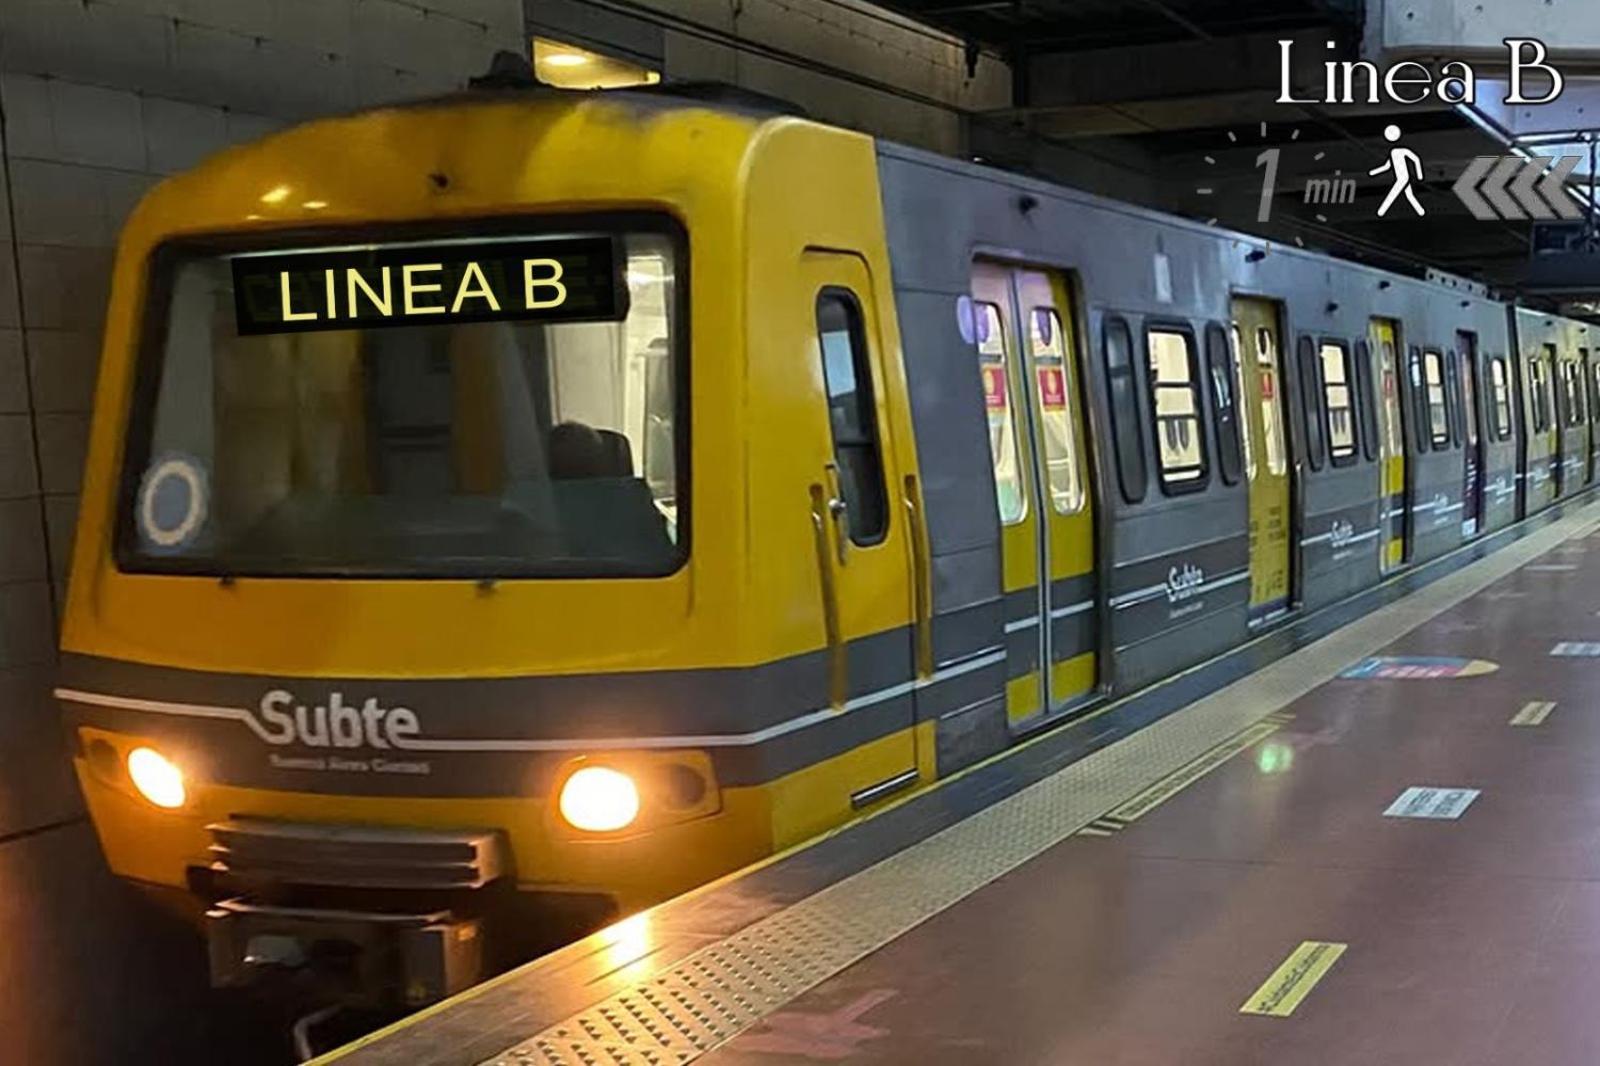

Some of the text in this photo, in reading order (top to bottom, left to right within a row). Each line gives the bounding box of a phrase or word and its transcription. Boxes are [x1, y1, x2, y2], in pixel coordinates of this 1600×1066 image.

[280, 257, 567, 322] LINEA B
[261, 690, 420, 750] Subte
